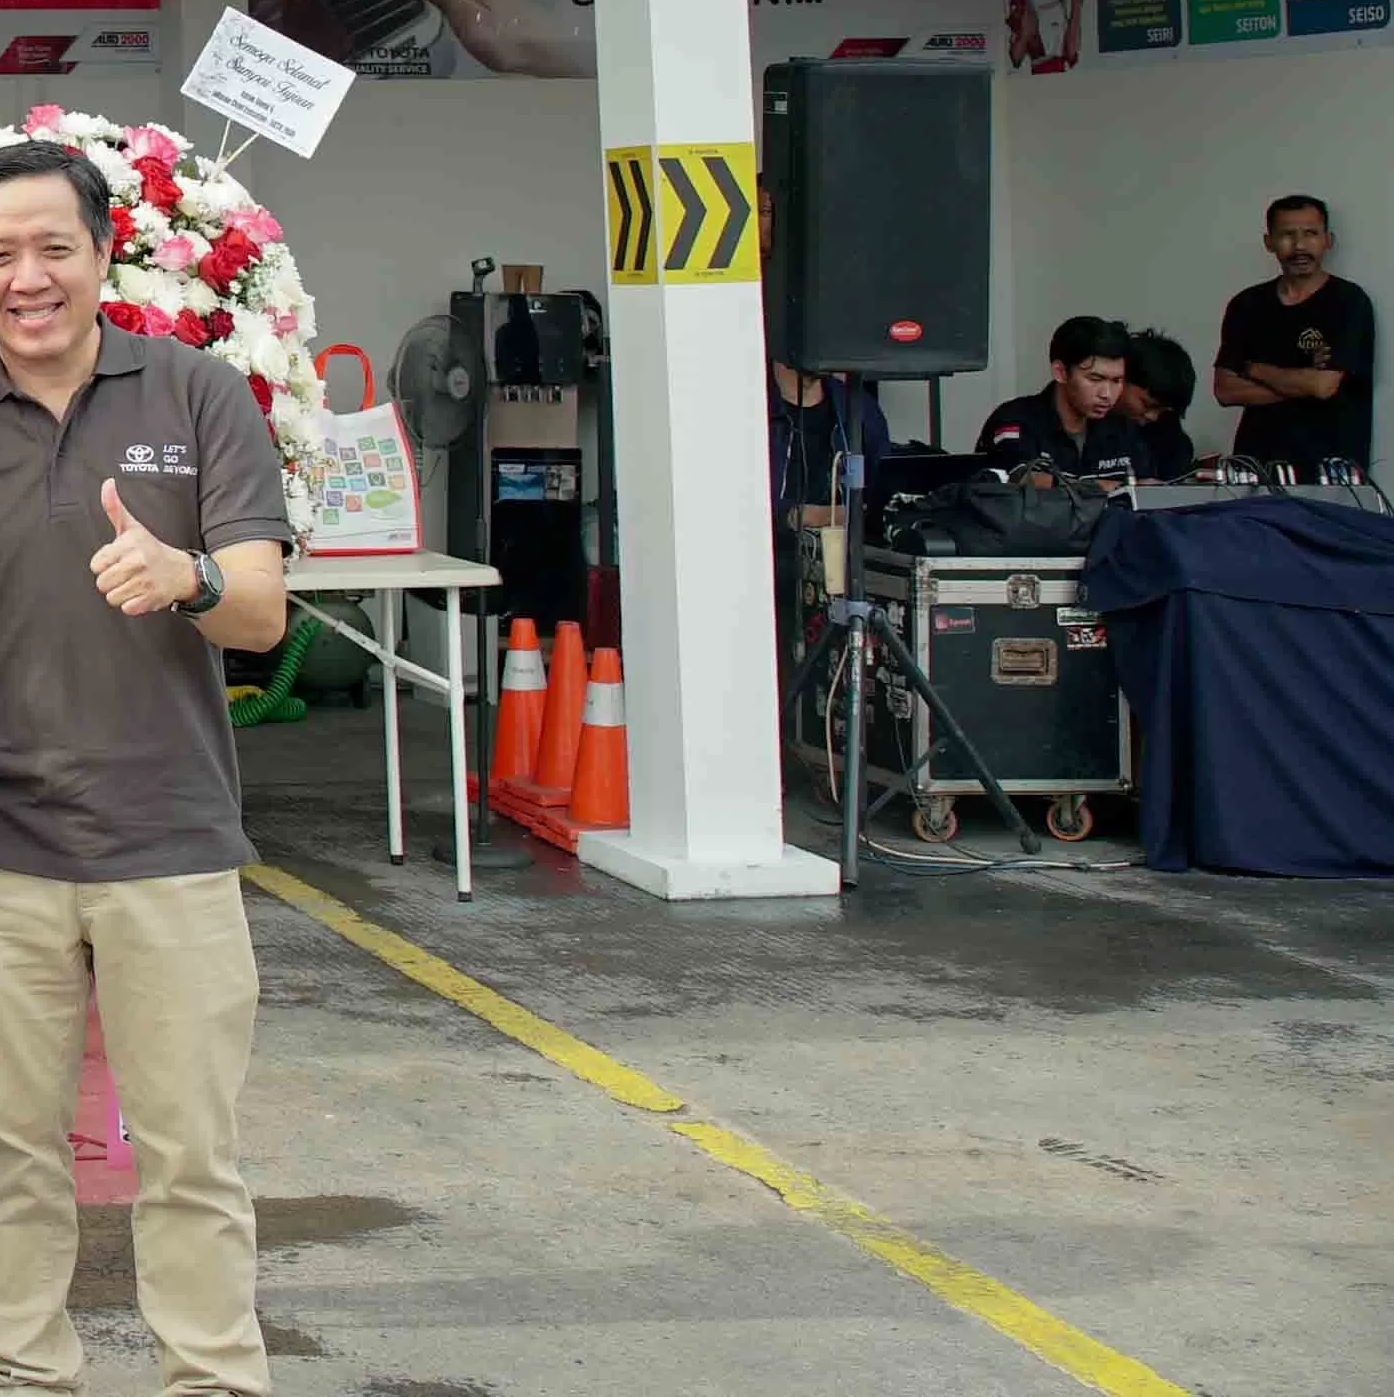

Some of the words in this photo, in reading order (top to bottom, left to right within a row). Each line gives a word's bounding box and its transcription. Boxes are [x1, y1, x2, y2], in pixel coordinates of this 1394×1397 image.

[1347, 4, 1385, 24] SEISO
[162, 454, 179, 464] GO
[118, 463, 160, 473] TOYOTA
